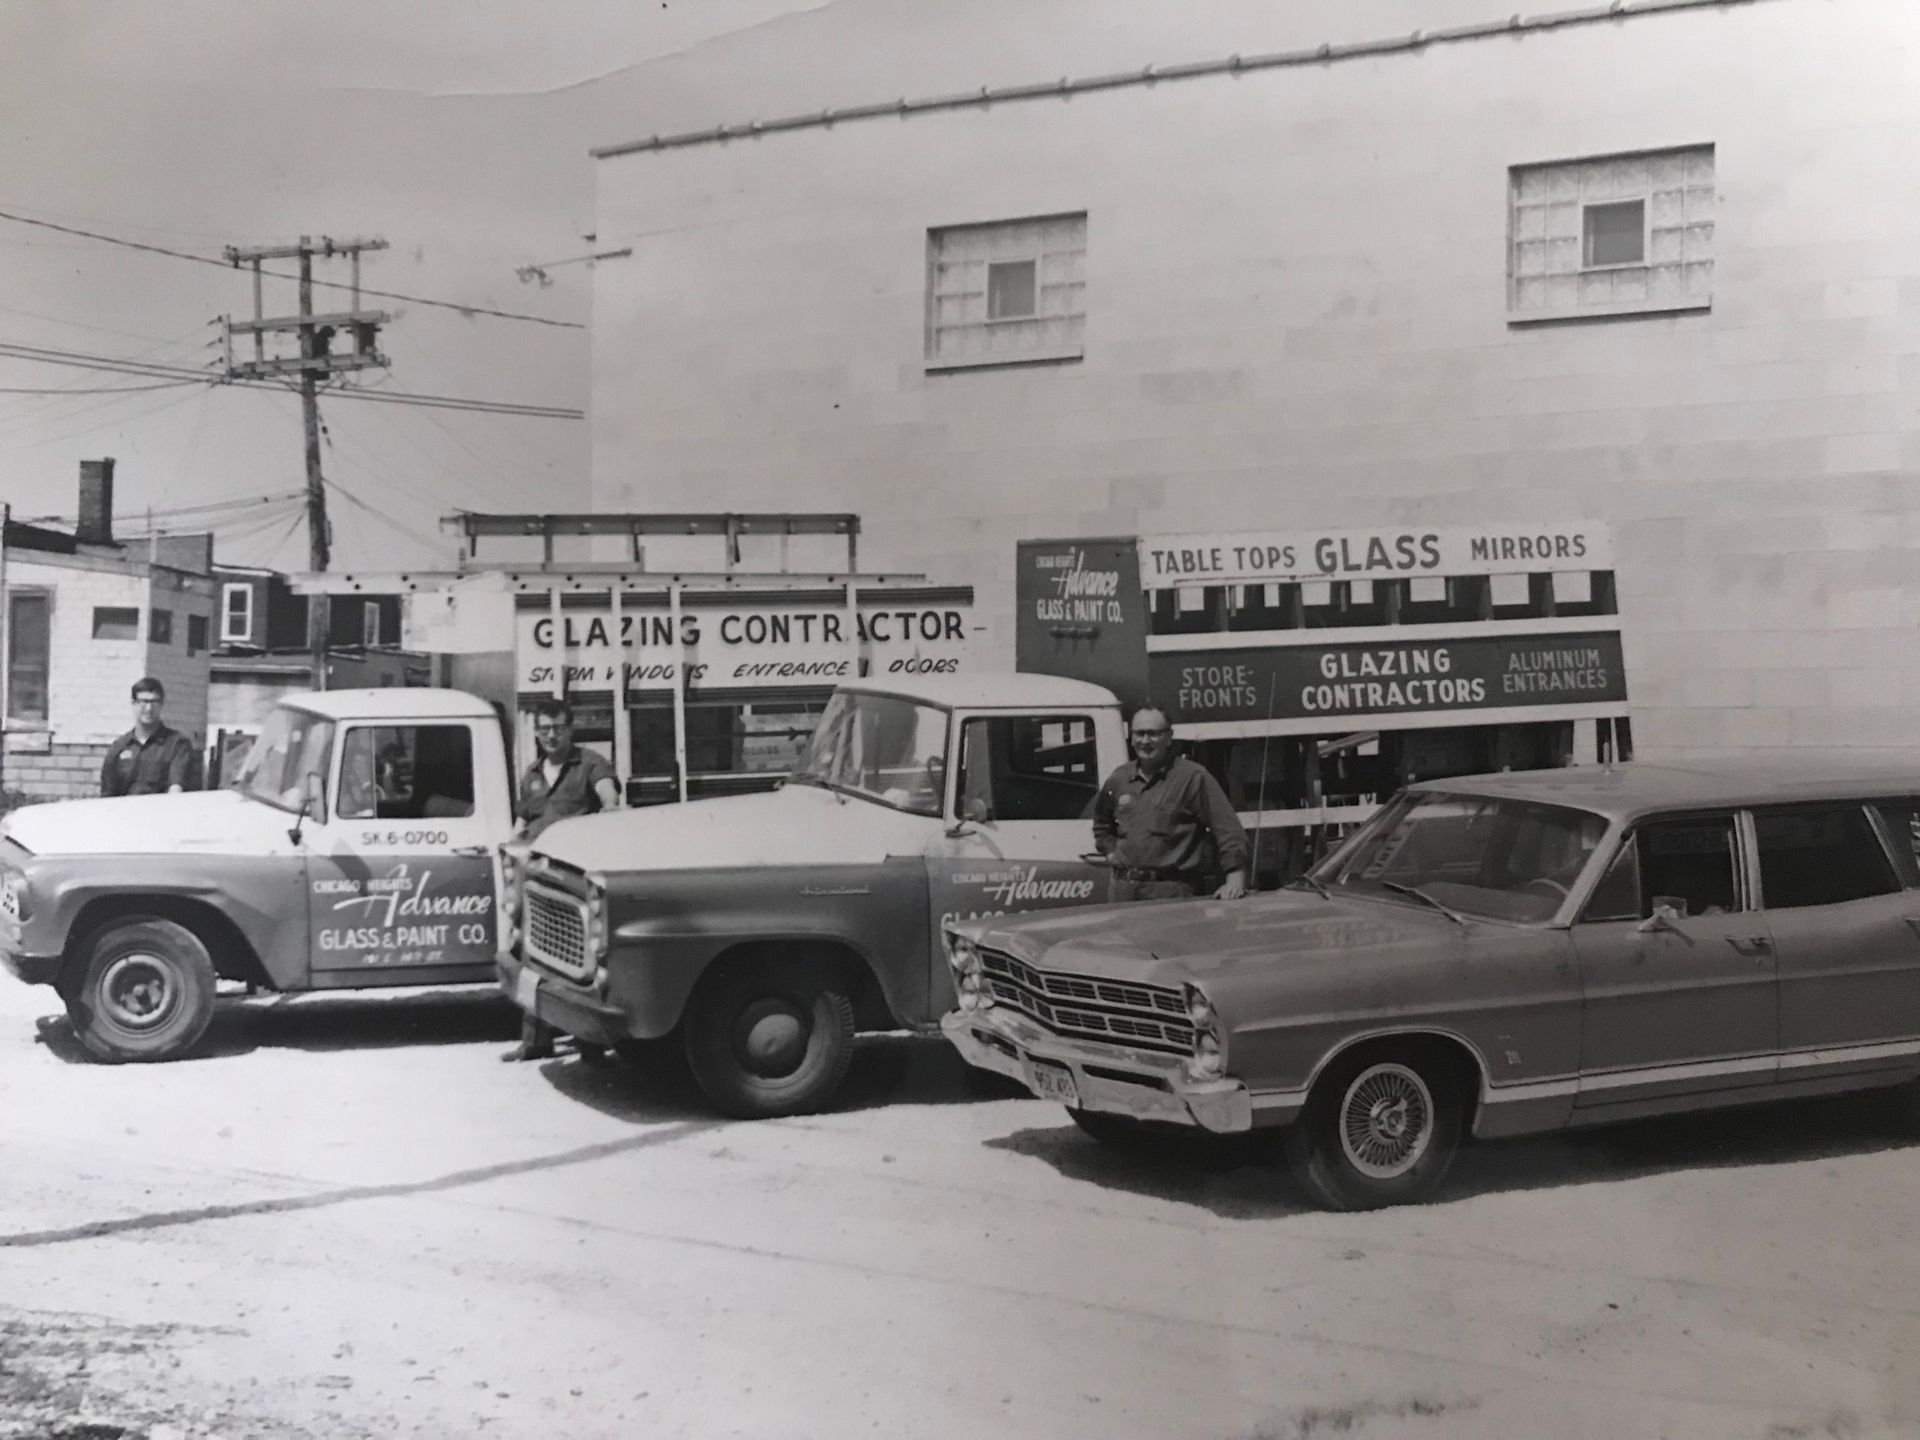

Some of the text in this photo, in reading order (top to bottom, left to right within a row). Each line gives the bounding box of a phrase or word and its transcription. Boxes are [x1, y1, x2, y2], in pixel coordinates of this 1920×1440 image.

[1152, 546, 1296, 574] TABLE TOPS
[1314, 534, 1440, 572] GLASS
[1471, 534, 1586, 560] MIRRORS
[1051, 547, 1118, 599] Advance
[1036, 598, 1064, 621] GLASS
[1074, 599, 1104, 622] PAINT
[1107, 600, 1124, 624] CO.
[533, 614, 701, 649] GLAZING
[720, 610, 965, 644] CONTRACTOR
[528, 665, 595, 683] STRM
[733, 660, 849, 678] ENTRANCE
[888, 658, 960, 674] DOORS
[1320, 648, 1451, 679] GLAZING
[1508, 649, 1601, 672] ALUMINUM
[1181, 665, 1254, 688] STORE-
[1503, 668, 1608, 693] ENTRANCES
[1179, 686, 1257, 710] FRONTS
[1302, 678, 1486, 710] CONTRACTORS
[333, 864, 491, 927] Advance
[982, 865, 1094, 906] Advance
[319, 924, 489, 950] GLASS & PAINT CO.
